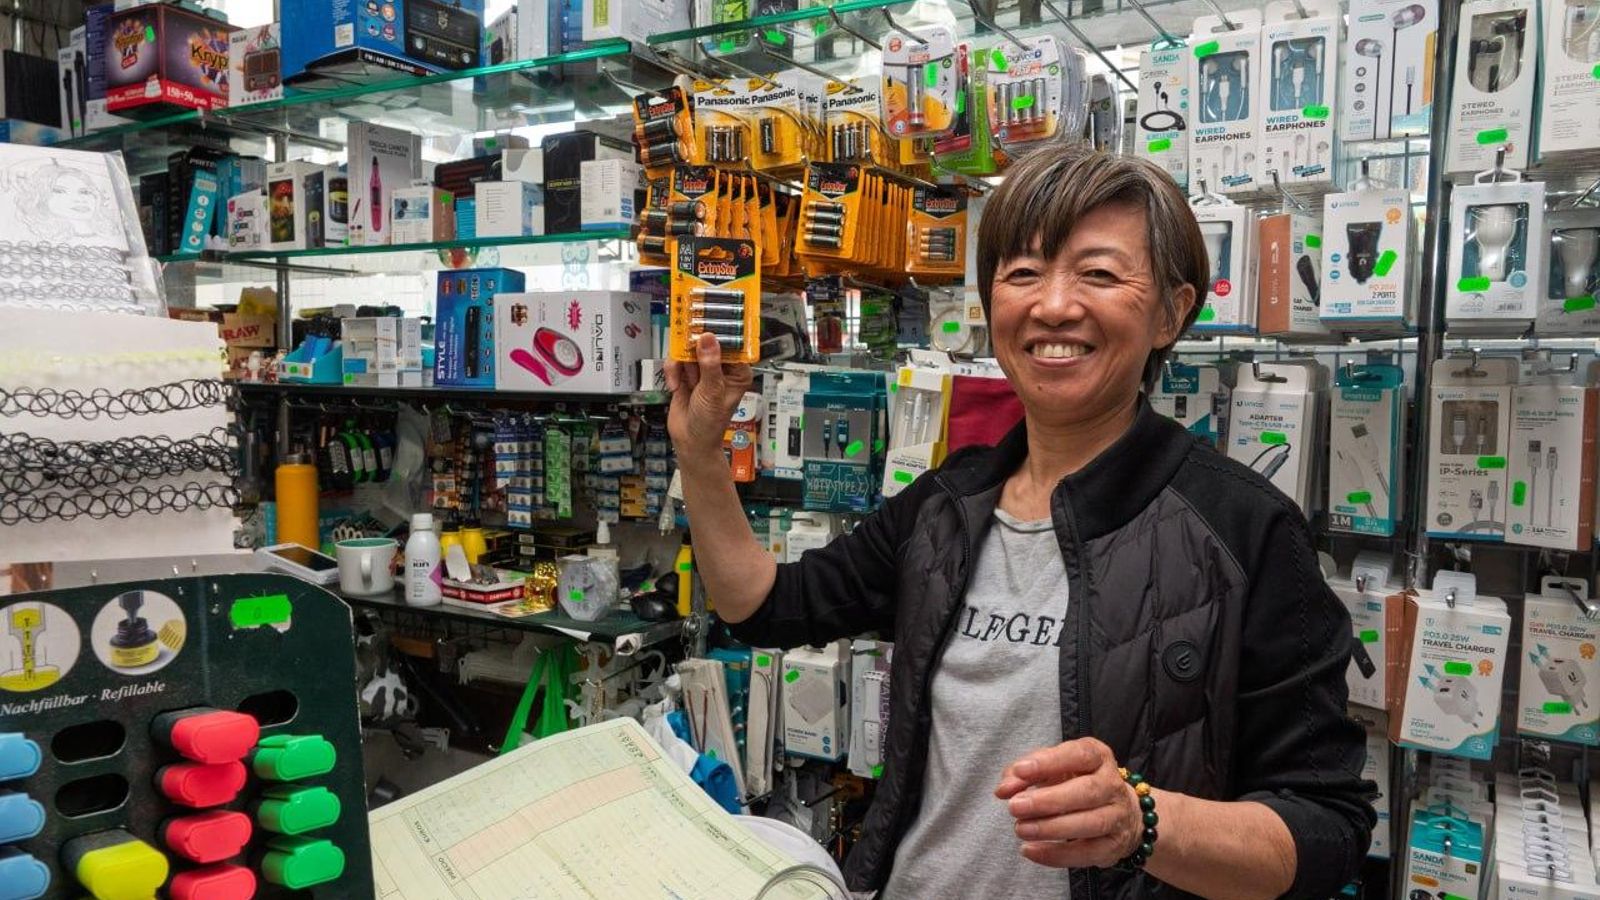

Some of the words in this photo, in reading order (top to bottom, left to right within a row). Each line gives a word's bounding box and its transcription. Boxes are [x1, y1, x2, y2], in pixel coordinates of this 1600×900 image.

[1152, 54, 1180, 64] SANDA
[697, 96, 750, 106] Panasonic
[751, 87, 796, 104] Panasonic
[829, 92, 876, 108] Panasonic
[1461, 101, 1495, 110] STEREO
[1266, 115, 1299, 124] WIRED
[1195, 127, 1226, 135] WIRED
[1266, 120, 1326, 132] EARPHONES
[1195, 132, 1251, 143] EARPHONES
[223, 325, 260, 341] RAW
[595, 313, 604, 372] DALING
[437, 341, 446, 380] STYLE
[1250, 414, 1283, 422] ADAPTER
[1440, 467, 1489, 476] IP-Series
[1331, 515, 1351, 527] 1M
[1450, 634, 1470, 642] 25W
[1558, 631, 1596, 640] CHARGER
[1422, 639, 1454, 649] TRAVEL
[1455, 643, 1496, 654] CHARGER
[0, 693, 87, 717] Nachfüllbar
[100, 681, 166, 701] Refillable
[1413, 852, 1444, 865] SANDA
